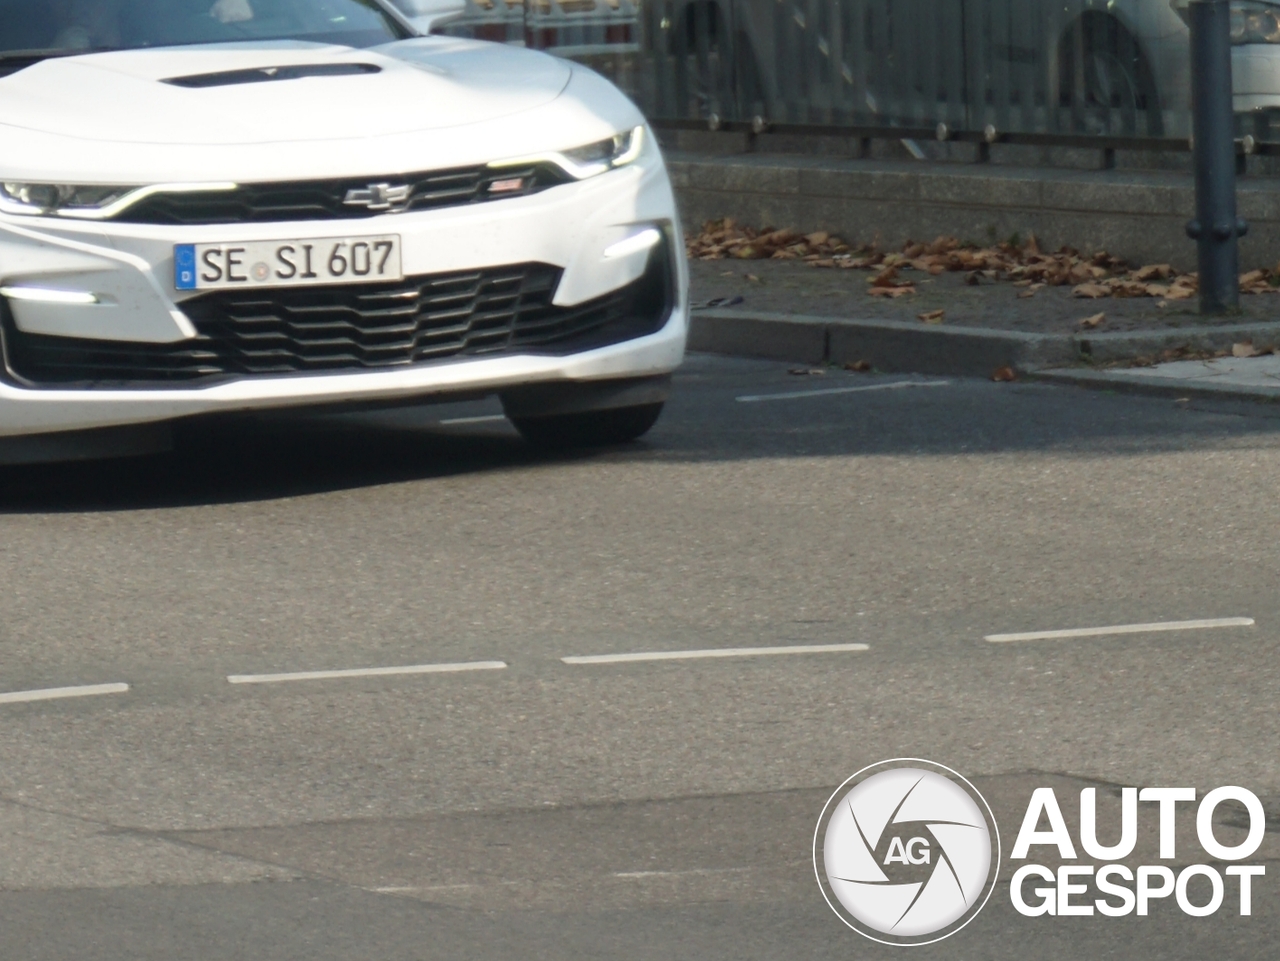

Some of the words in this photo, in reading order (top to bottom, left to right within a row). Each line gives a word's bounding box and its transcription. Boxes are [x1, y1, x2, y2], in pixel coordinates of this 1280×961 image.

[201, 247, 248, 283] SE
[275, 244, 317, 280] SI
[327, 240, 394, 277] 607
